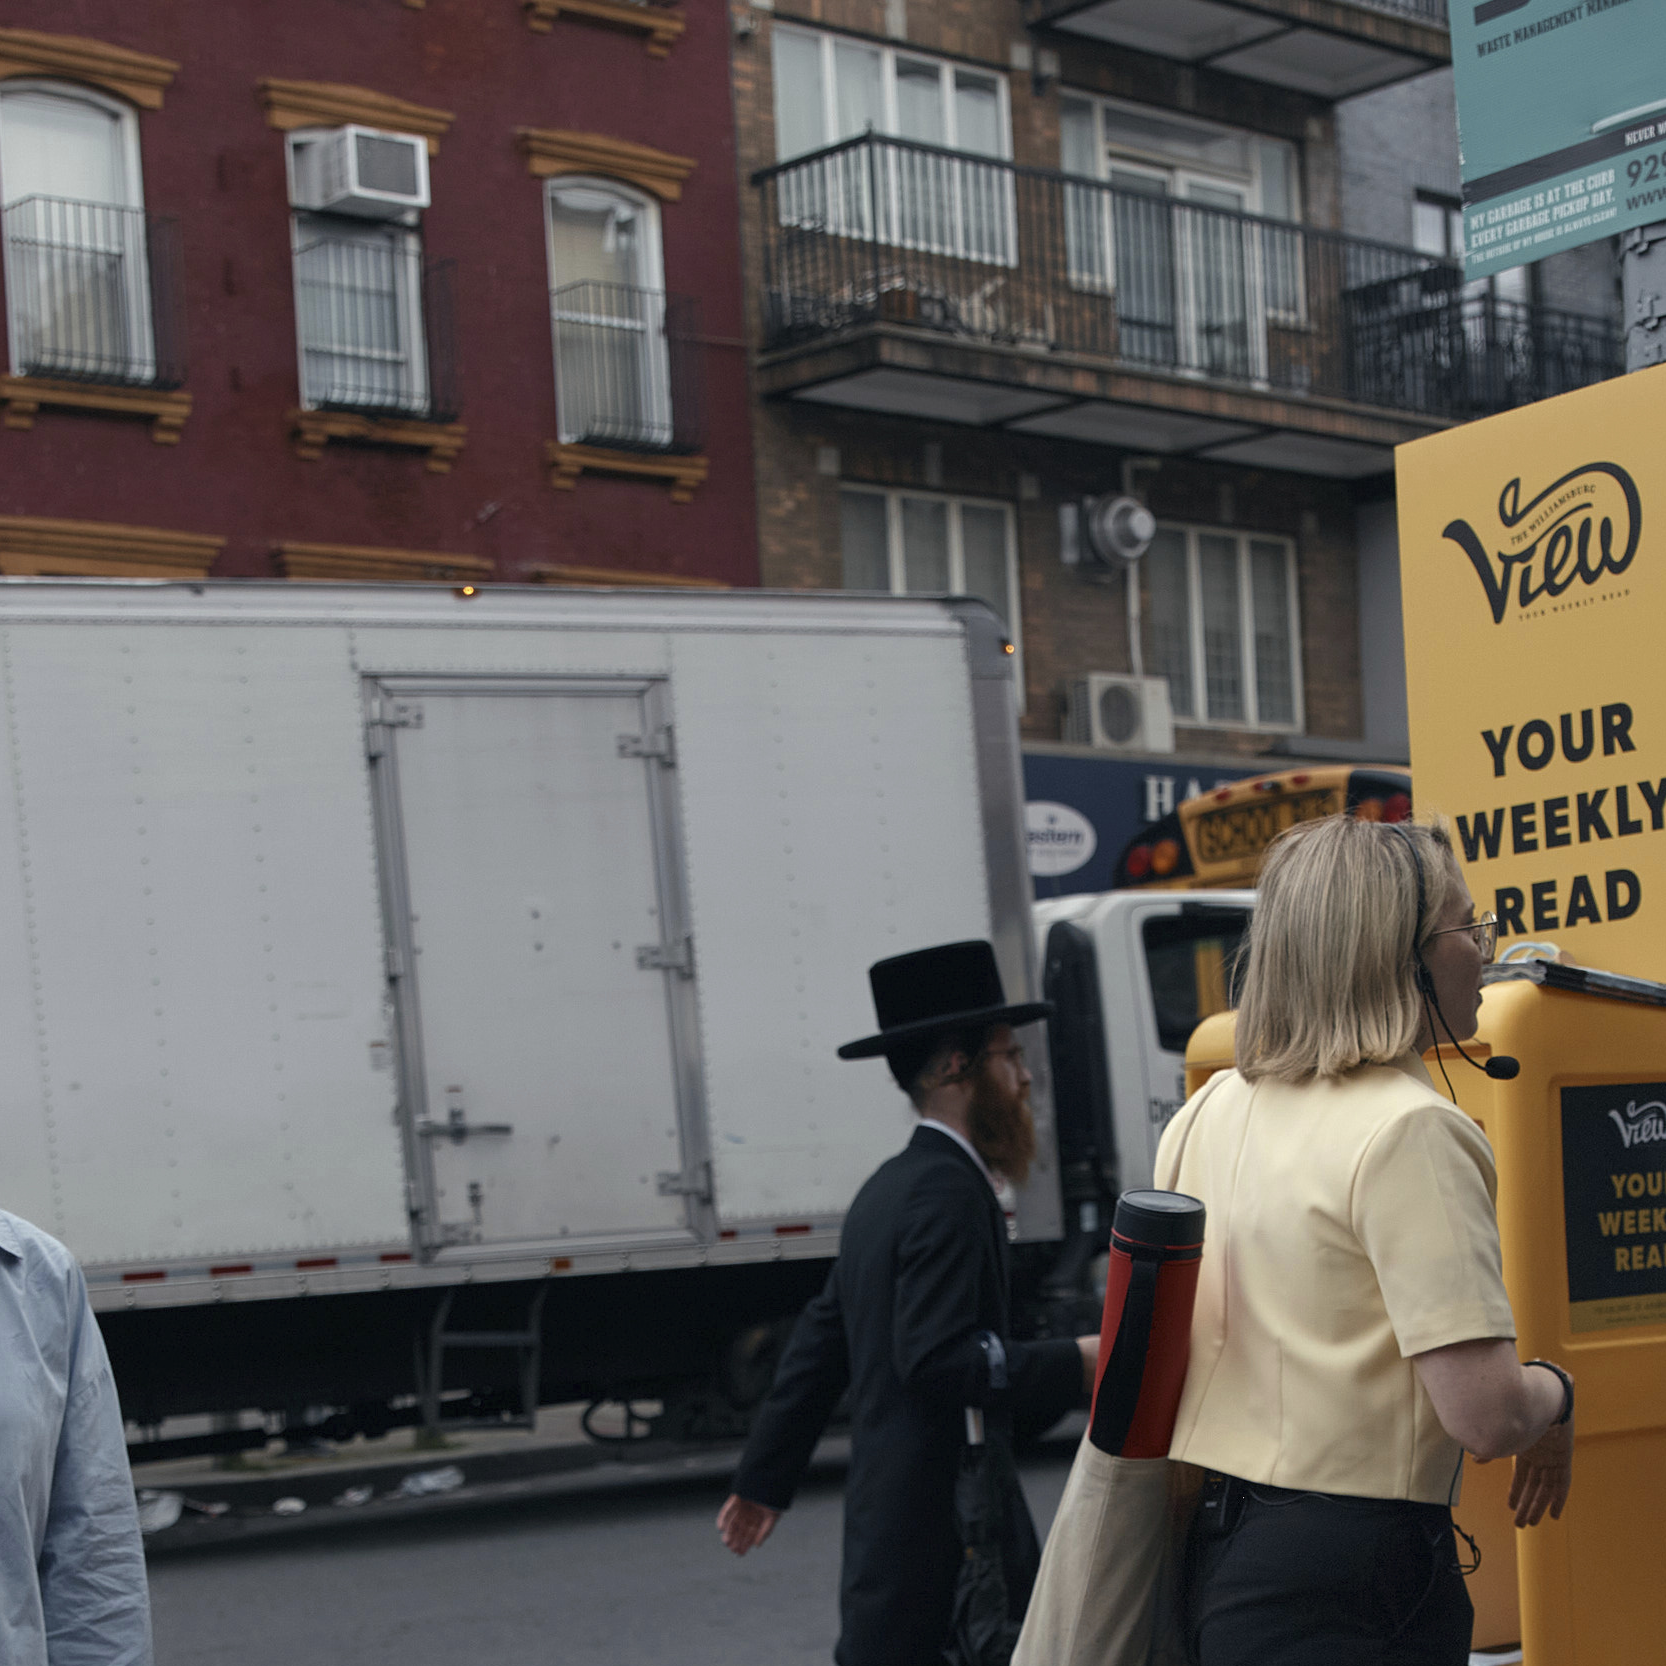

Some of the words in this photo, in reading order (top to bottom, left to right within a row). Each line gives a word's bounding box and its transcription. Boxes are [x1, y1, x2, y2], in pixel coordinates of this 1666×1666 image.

[1476, 33, 1512, 58] WASTE
[1514, 5, 1584, 45] MANAGEMENT
[1624, 124, 1656, 147] NEVER
[1470, 214, 1486, 232] MY
[1487, 196, 1533, 226] GARBAGE
[1534, 191, 1545, 210] IS
[1546, 185, 1562, 205] AT
[1564, 178, 1585, 200] THE
[1586, 168, 1616, 193] CURB
[1471, 226, 1504, 249] EVERY
[1505, 208, 1552, 239] GARBAGE
[1552, 195, 1590, 222] PICKUP
[1480, 701, 1637, 778] YOUR
[1494, 868, 1643, 938] READ
